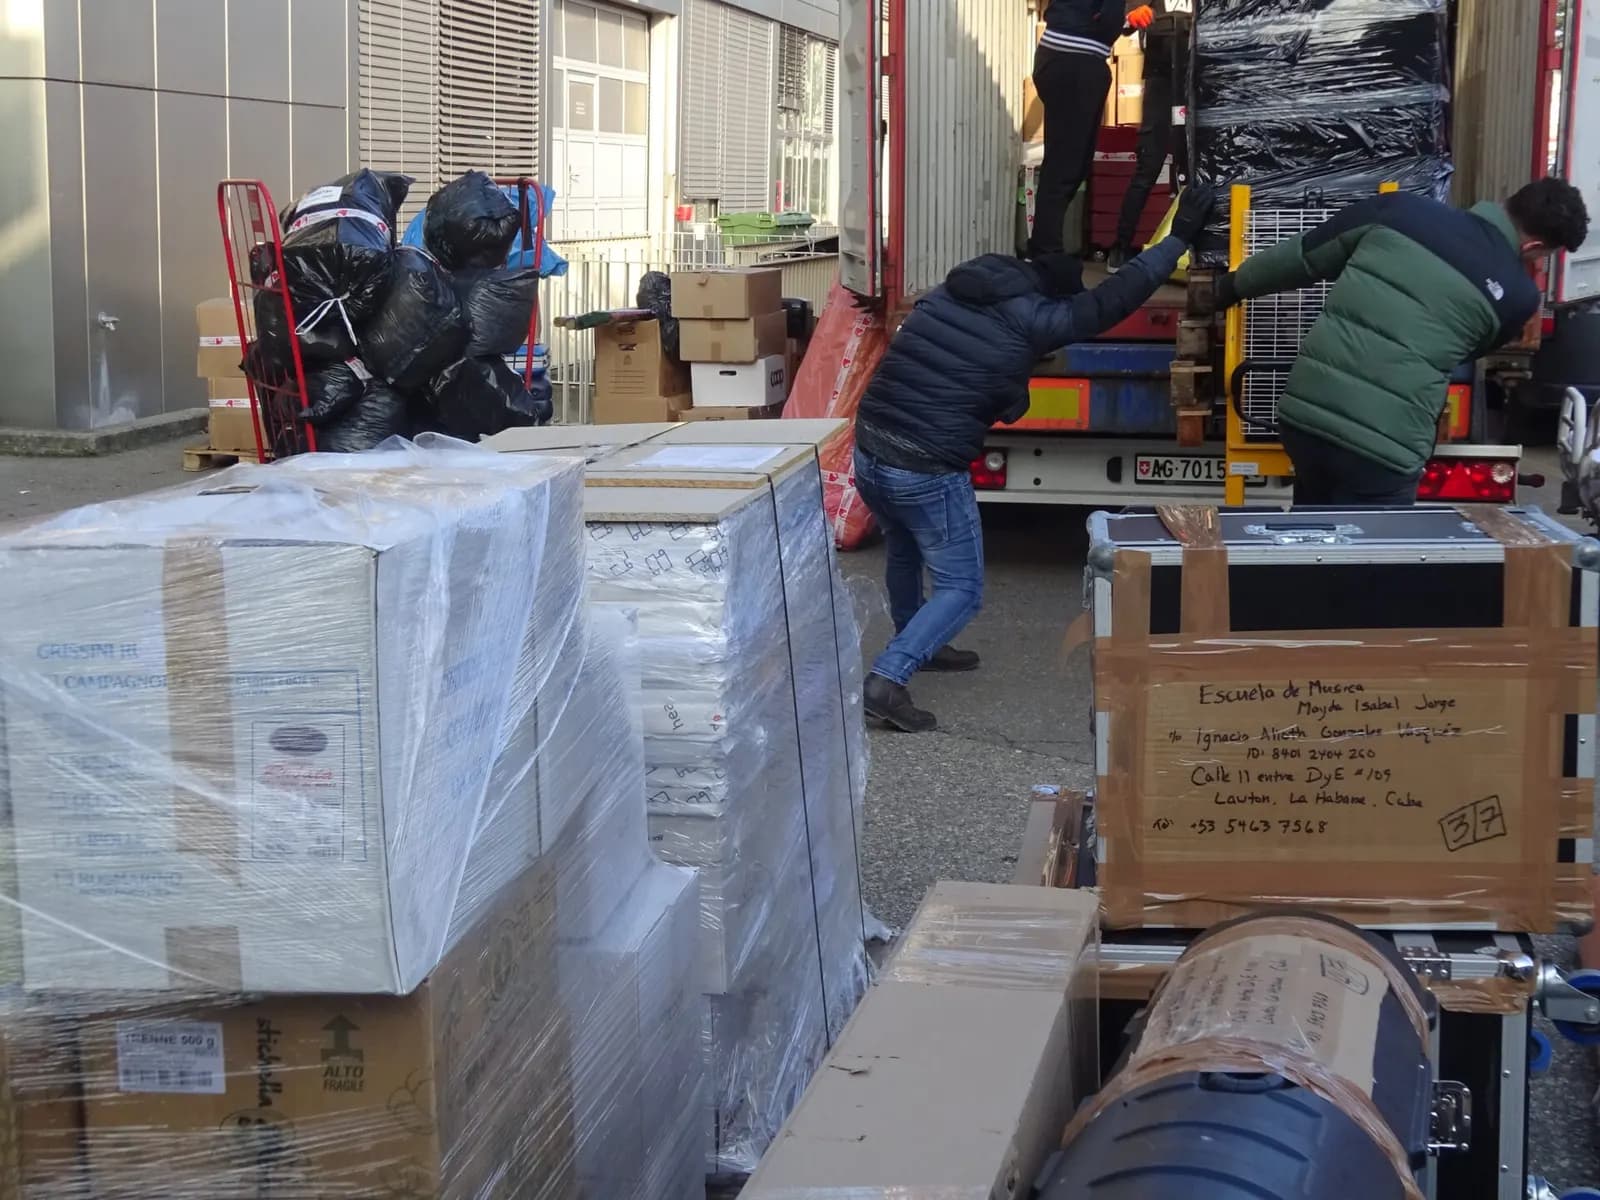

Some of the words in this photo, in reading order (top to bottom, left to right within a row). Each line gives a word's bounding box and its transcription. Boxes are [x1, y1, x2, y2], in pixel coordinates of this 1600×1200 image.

[1283, 679, 1300, 700] de
[1289, 792, 1308, 804] La
[1224, 818, 1271, 834] 5463
[1278, 819, 1328, 834] 7568
[323, 1065, 364, 1078] ALTO
[323, 1079, 364, 1093] FRAGILE
